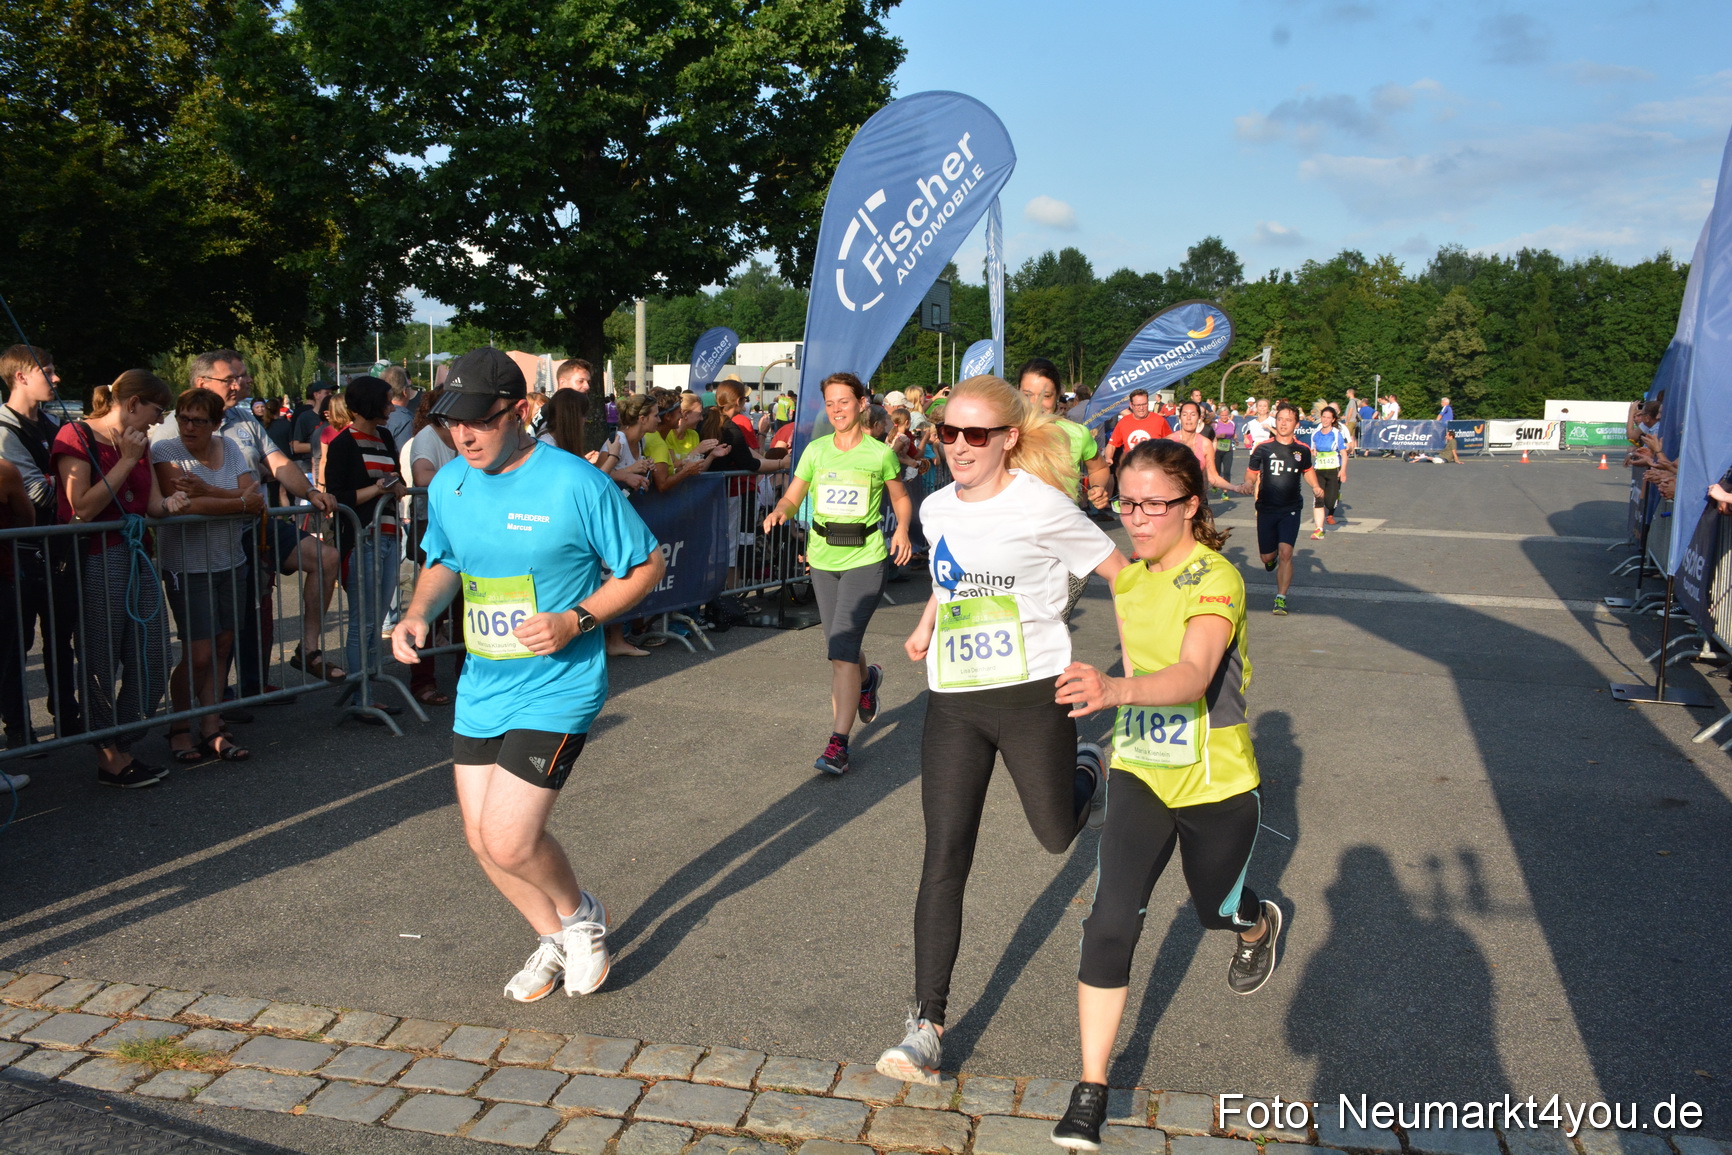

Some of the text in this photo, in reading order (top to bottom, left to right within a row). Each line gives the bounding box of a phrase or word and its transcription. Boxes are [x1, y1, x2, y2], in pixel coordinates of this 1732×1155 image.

[862, 131, 974, 286] Fischer
[896, 163, 985, 286] AUTOMOBILE
[701, 335, 729, 373] Fischer
[969, 346, 993, 377] Fischer
[1108, 339, 1197, 392] Frischmann
[1164, 356, 1187, 371] Druck
[1200, 335, 1227, 353] Medien
[1388, 431, 1432, 441] Fischer
[1516, 427, 1543, 440] swn
[1569, 426, 1589, 438] AOK
[826, 488, 859, 506] 222
[506, 522, 533, 531] Marcus
[514, 513, 550, 524] PFLEIDERER
[937, 559, 1016, 589] Running
[467, 607, 527, 637] 1066
[945, 629, 1014, 663] 1583
[1123, 708, 1188, 746] 1182
[1134, 746, 1148, 755] Maria
